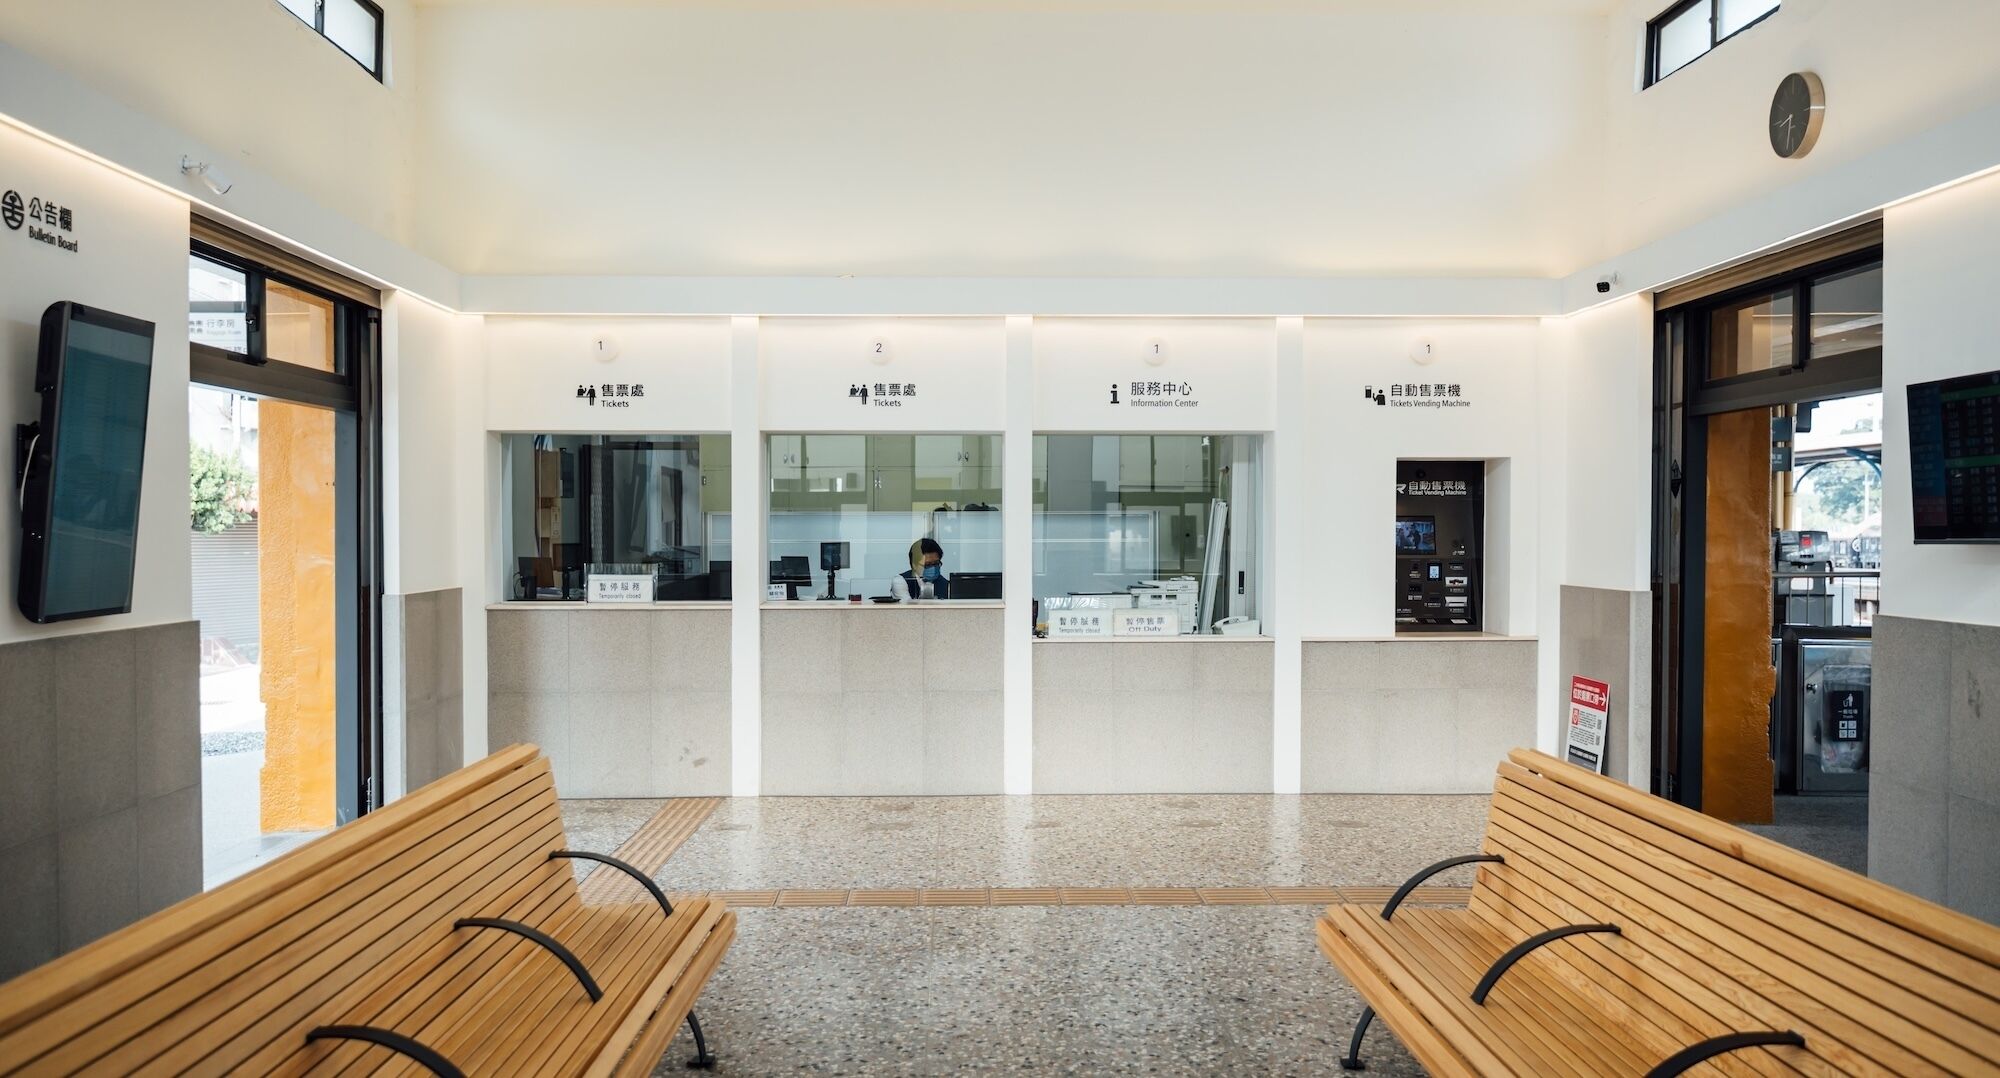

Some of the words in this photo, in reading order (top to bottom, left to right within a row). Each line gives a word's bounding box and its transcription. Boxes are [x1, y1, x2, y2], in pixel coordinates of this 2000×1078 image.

[29, 196, 73, 232] 公告欄
[29, 225, 57, 246] Bulletin
[58, 235, 78, 253] Board
[598, 340, 603, 351] 1
[875, 342, 883, 353] 2
[1154, 344, 1160, 354] 1
[1426, 344, 1432, 354] 1
[601, 383, 645, 397] 售票處
[873, 382, 917, 396] 售票處
[1130, 381, 1193, 396] 服務中心
[1391, 383, 1461, 397] 自動售票機
[601, 399, 630, 408] Tickets
[873, 398, 902, 407] Tickets
[1130, 398, 1173, 407] Information
[1174, 399, 1199, 407] Center
[1390, 399, 1413, 407] Tickets
[1413, 399, 1441, 409] Vending
[1442, 399, 1471, 407] Machine
[1408, 480, 1467, 491] 自動售票機
